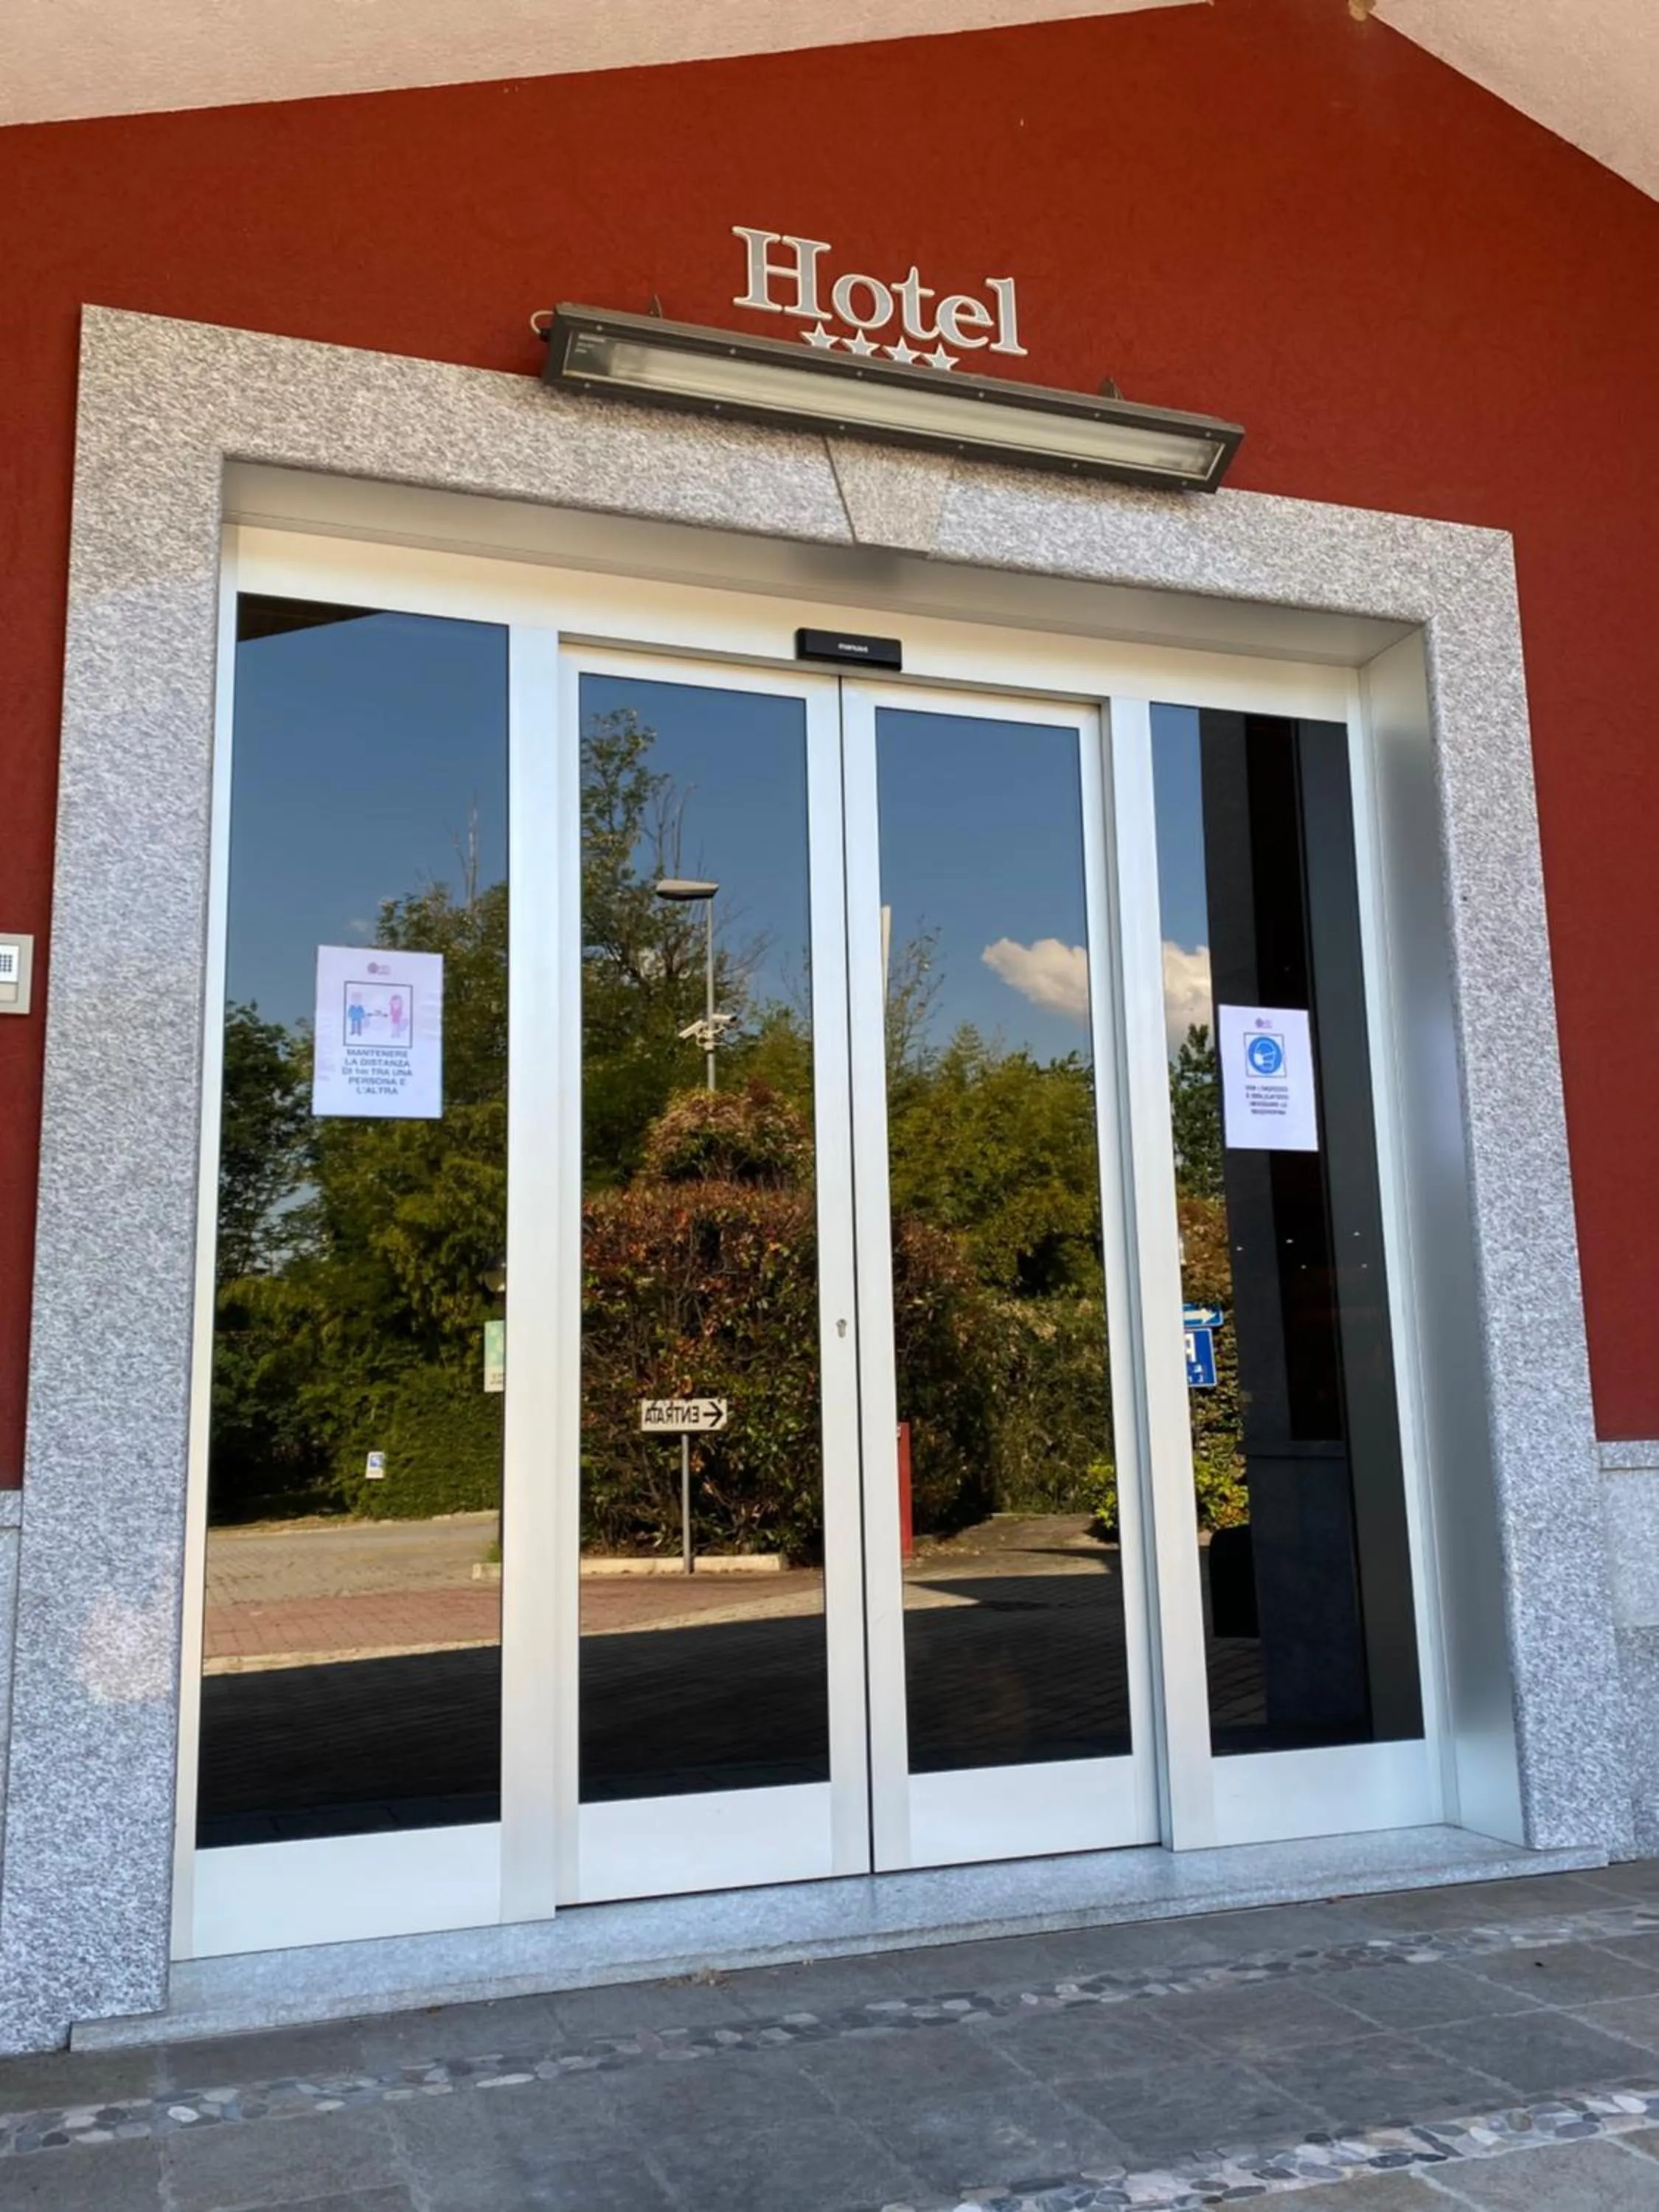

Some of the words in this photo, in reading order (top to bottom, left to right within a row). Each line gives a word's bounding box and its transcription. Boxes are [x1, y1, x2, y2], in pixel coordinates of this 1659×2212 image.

[731, 225, 1029, 355] Hotel
[347, 1048, 408, 1058] MANTENERE
[344, 1057, 358, 1066] LA
[360, 1058, 411, 1068] DISTANZA
[348, 1077, 397, 1086] PERSONA
